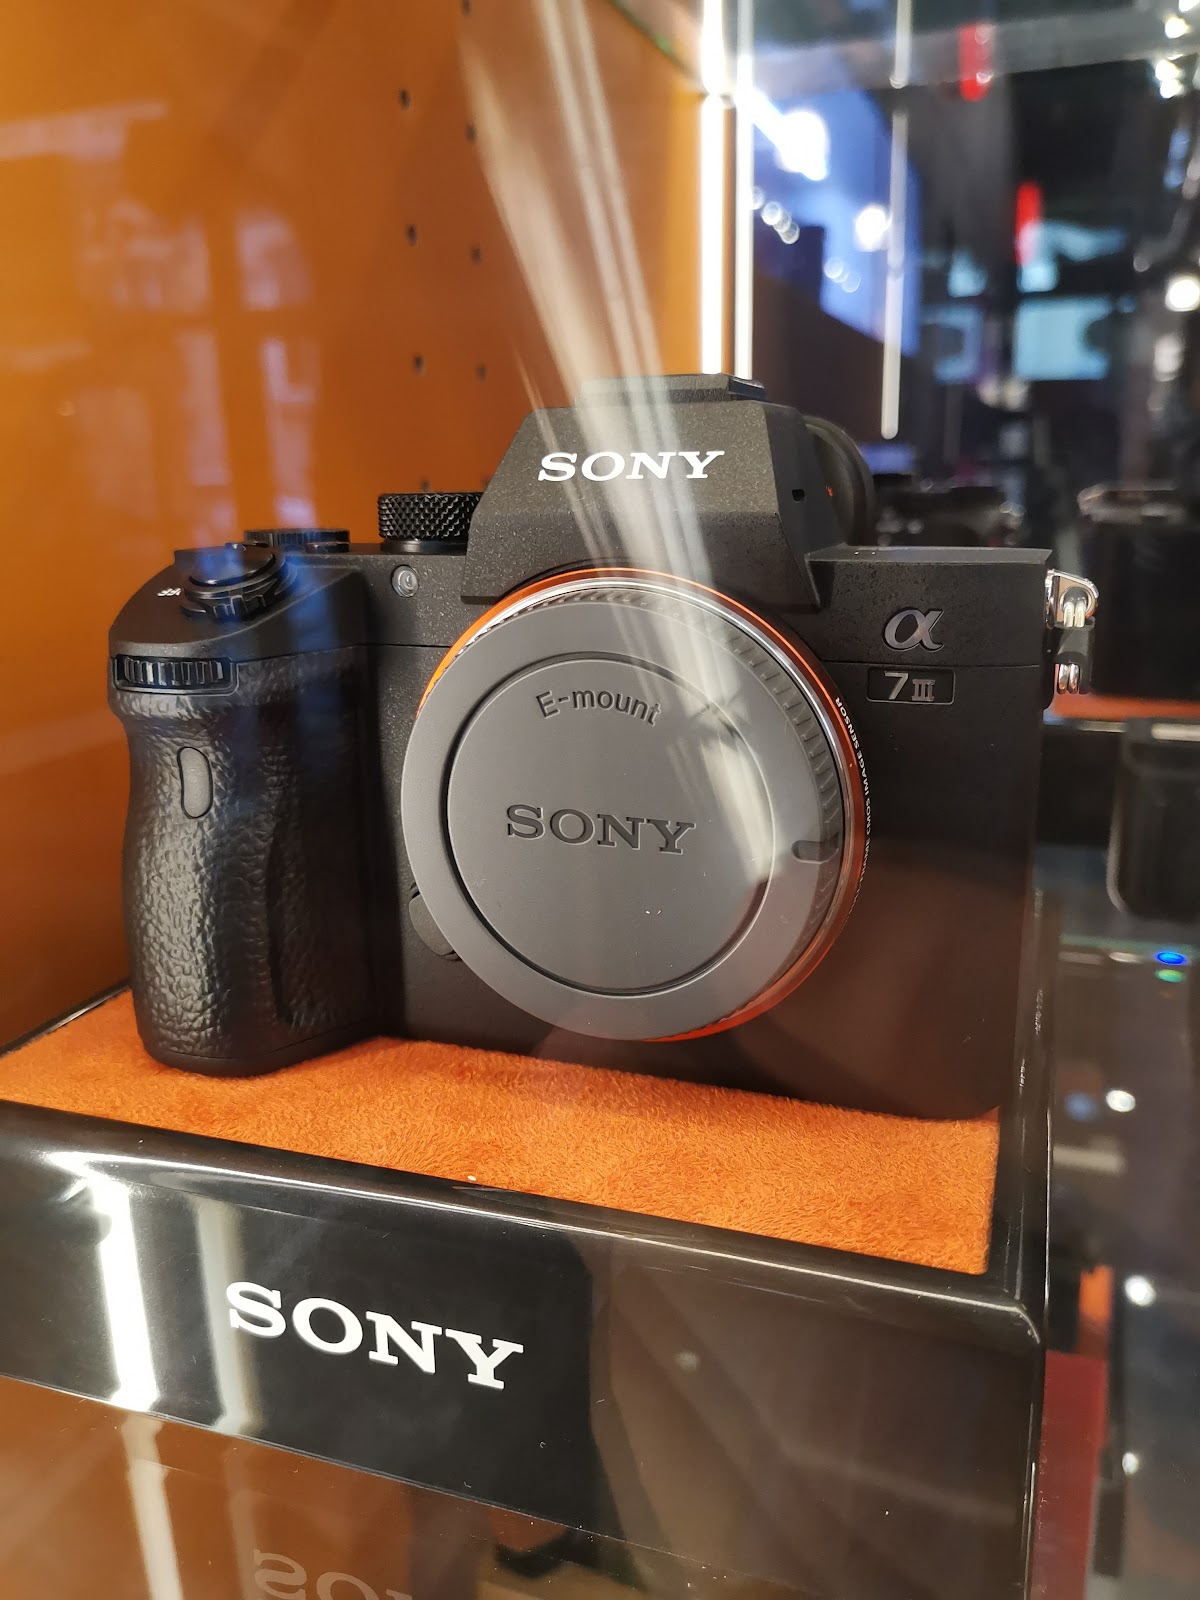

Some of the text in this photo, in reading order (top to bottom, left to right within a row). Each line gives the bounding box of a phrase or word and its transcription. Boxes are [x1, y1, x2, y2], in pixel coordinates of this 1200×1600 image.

[537, 450, 725, 481] SONY
[884, 671, 909, 700] 7
[535, 690, 662, 727] E-mount
[835, 696, 859, 750] SENSOR
[857, 750, 869, 795] IMAGE
[507, 804, 695, 855] SONY
[226, 1281, 524, 1389] SONY
